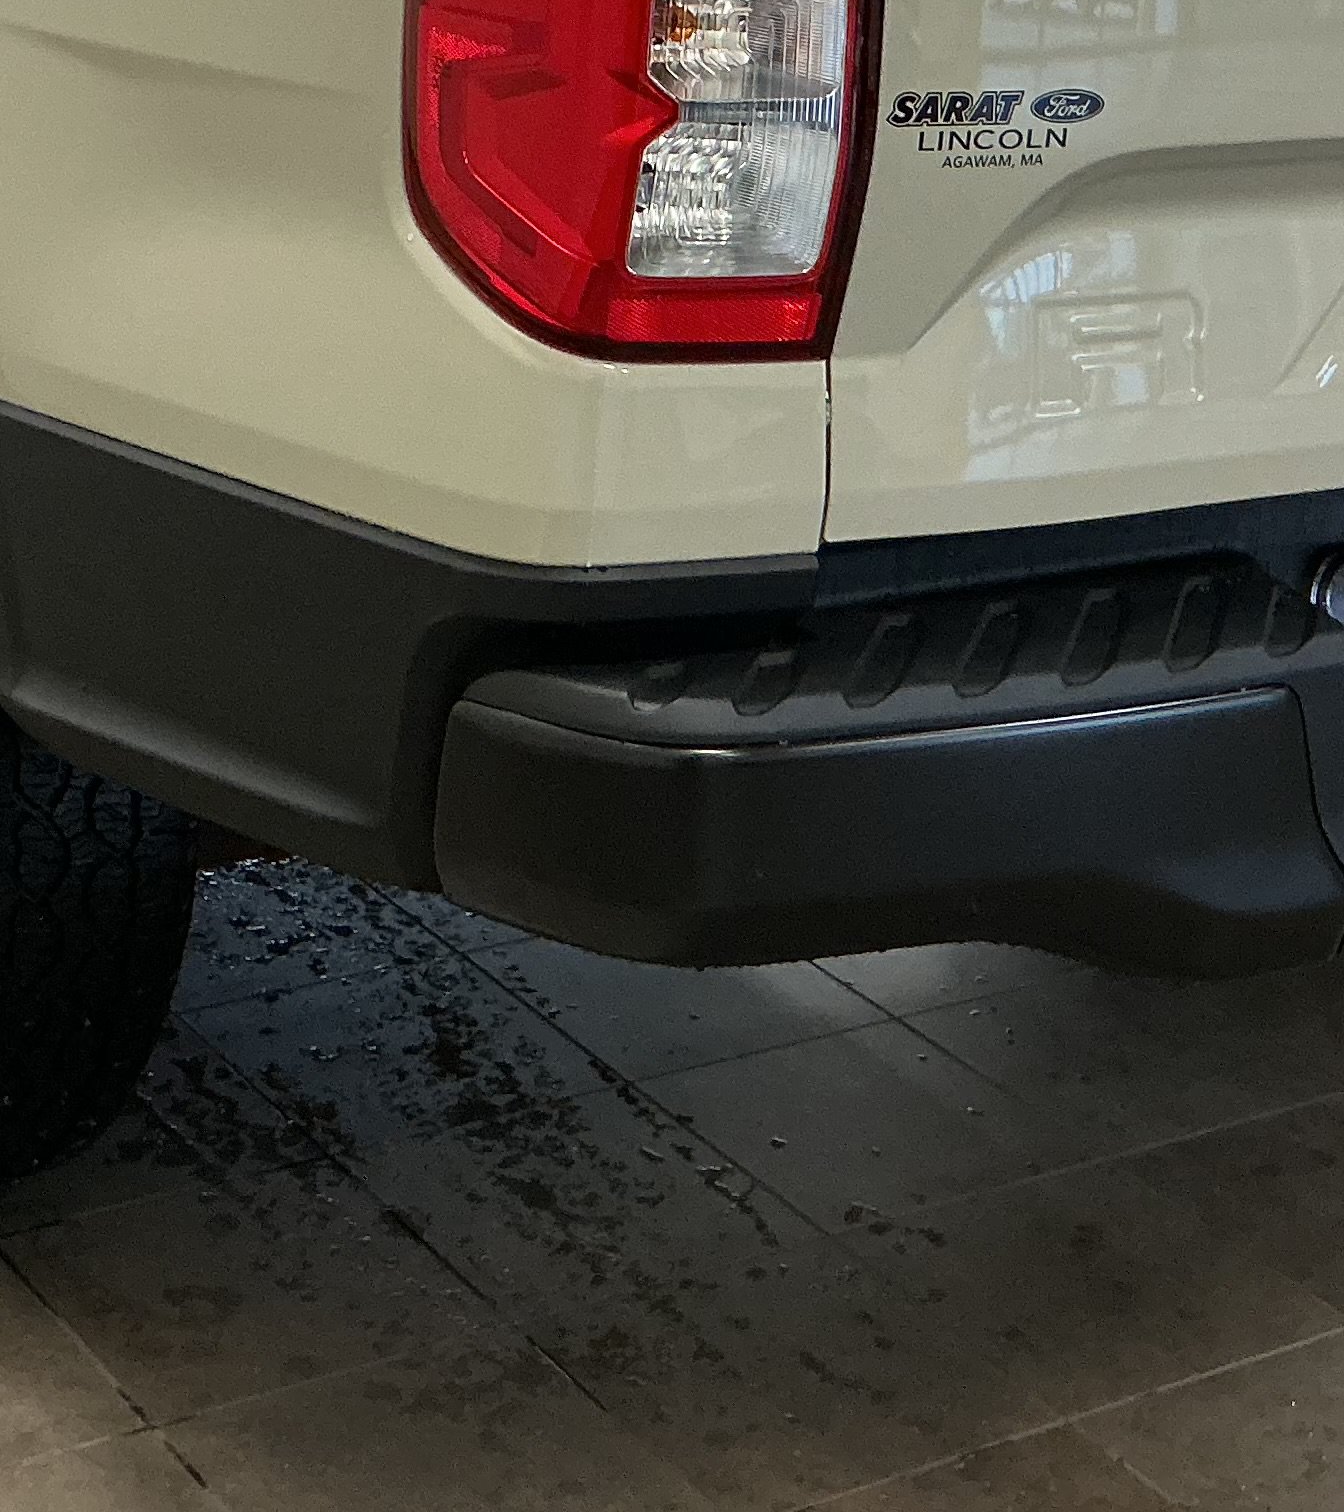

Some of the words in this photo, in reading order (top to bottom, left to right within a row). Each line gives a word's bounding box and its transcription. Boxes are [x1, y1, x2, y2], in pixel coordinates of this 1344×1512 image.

[886, 90, 1025, 128] SARAT
[917, 127, 1068, 152] LINCOLN
[941, 154, 1015, 169] AGAWAM,
[1020, 153, 1044, 167] MA
